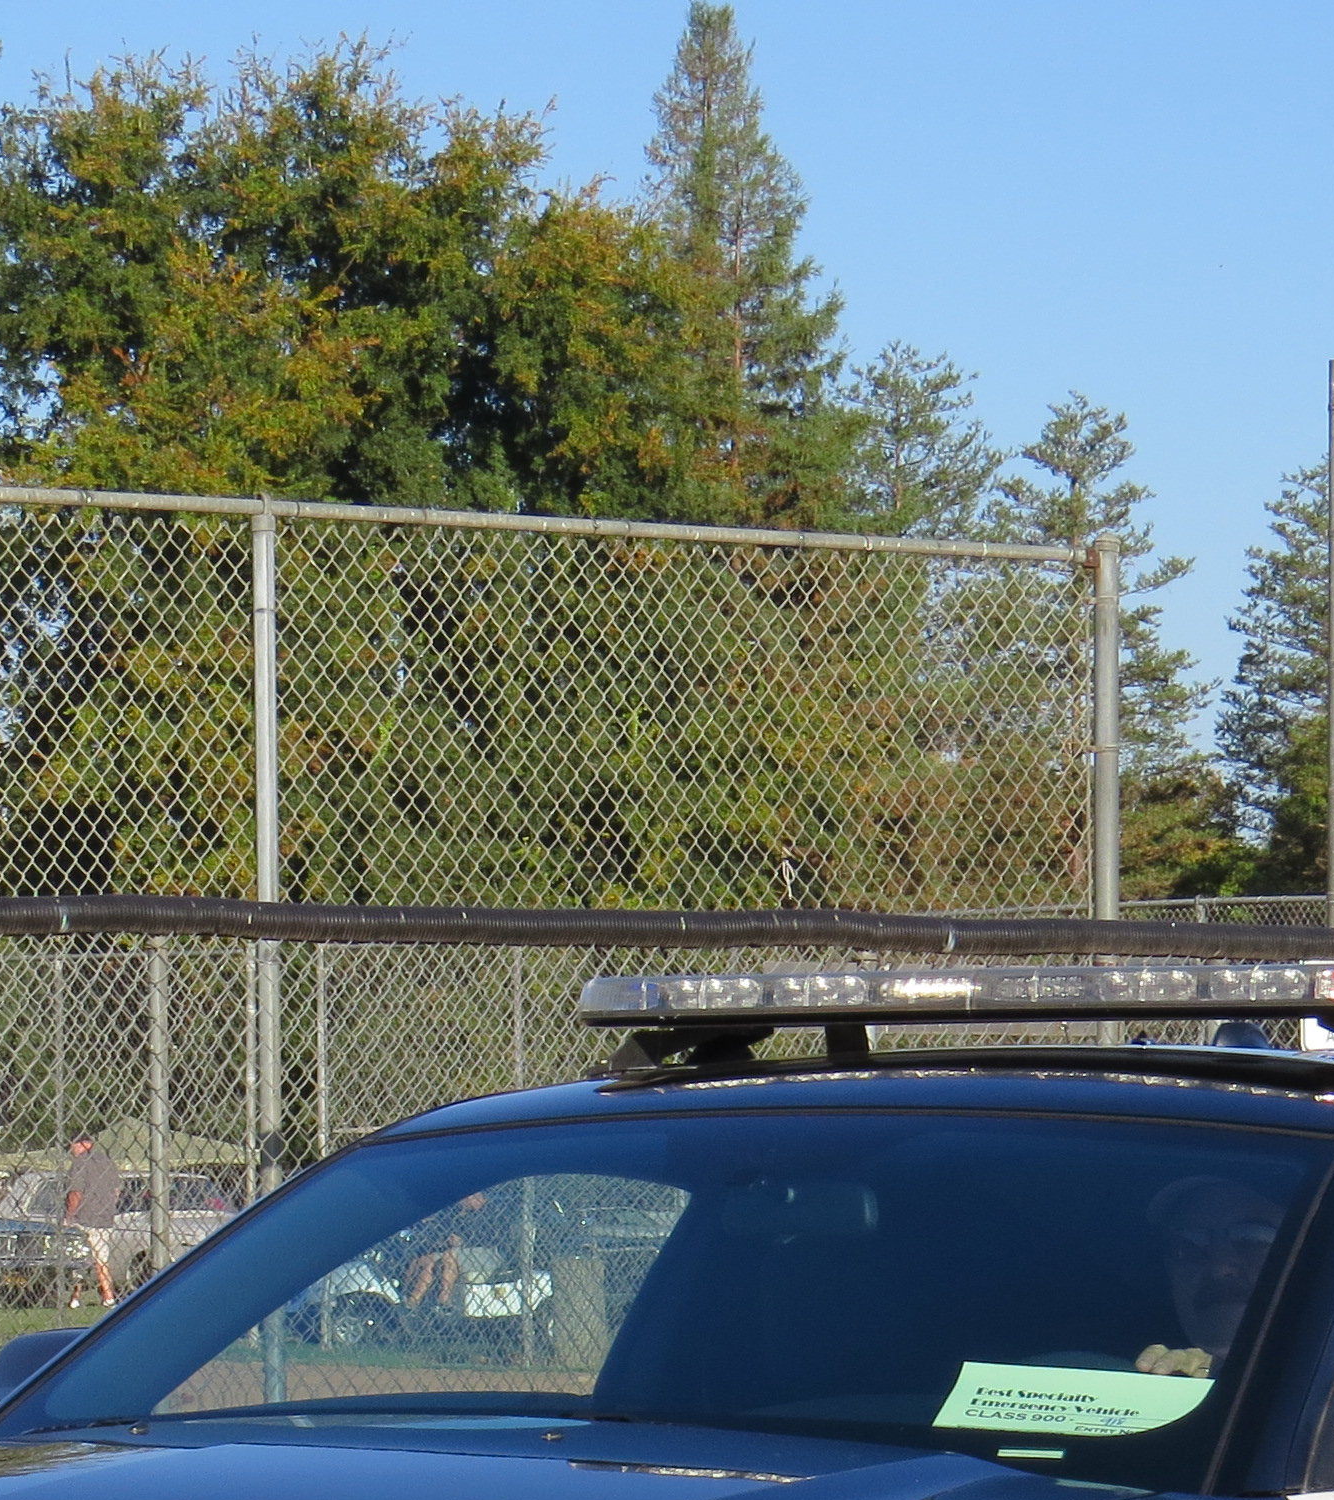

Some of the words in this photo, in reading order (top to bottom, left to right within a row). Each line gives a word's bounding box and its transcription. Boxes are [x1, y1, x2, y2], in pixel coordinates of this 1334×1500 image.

[975, 1387, 1014, 1398] Best
[1017, 1389, 1097, 1402] Specialty
[969, 1398, 1067, 1412] Emergency
[1074, 1405, 1140, 1417] Vehicle
[965, 1408, 1028, 1421] CLASS
[1030, 1413, 1067, 1423] 900
[1074, 1425, 1116, 1434] ENTRY
